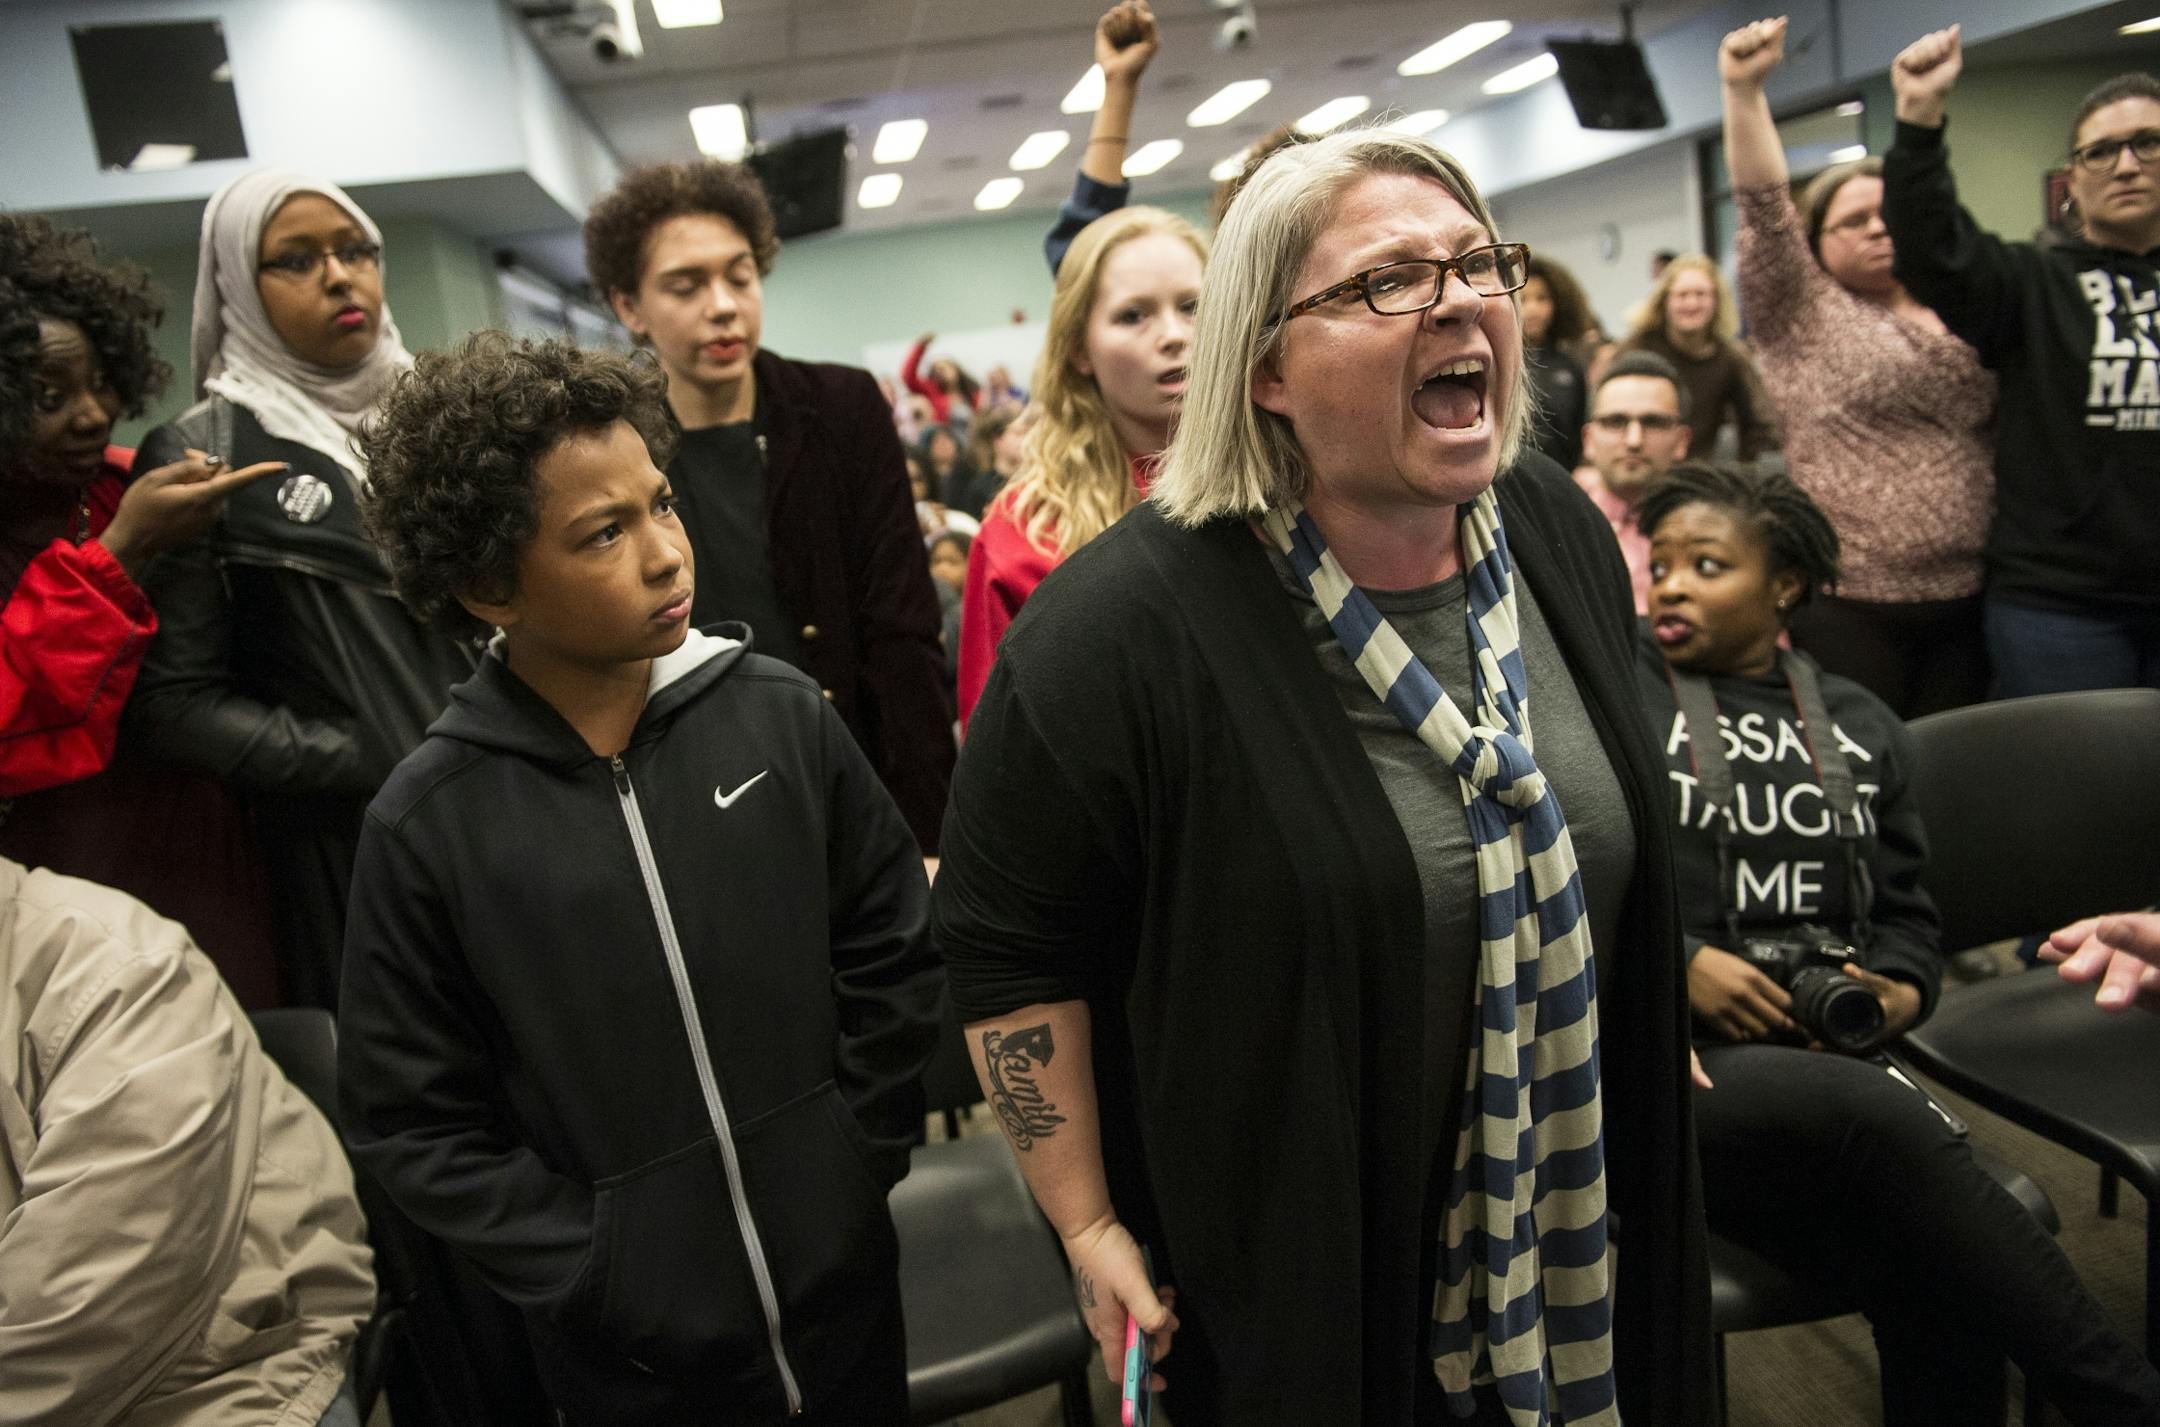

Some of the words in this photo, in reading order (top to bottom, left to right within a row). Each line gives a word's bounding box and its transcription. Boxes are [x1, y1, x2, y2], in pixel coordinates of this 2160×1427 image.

[2077, 267, 2160, 316] BL
[2092, 312, 2160, 358] LI
[2087, 357, 2160, 408] MA
[1666, 710, 1873, 763] ASSAA
[1735, 858, 1824, 914] ME
